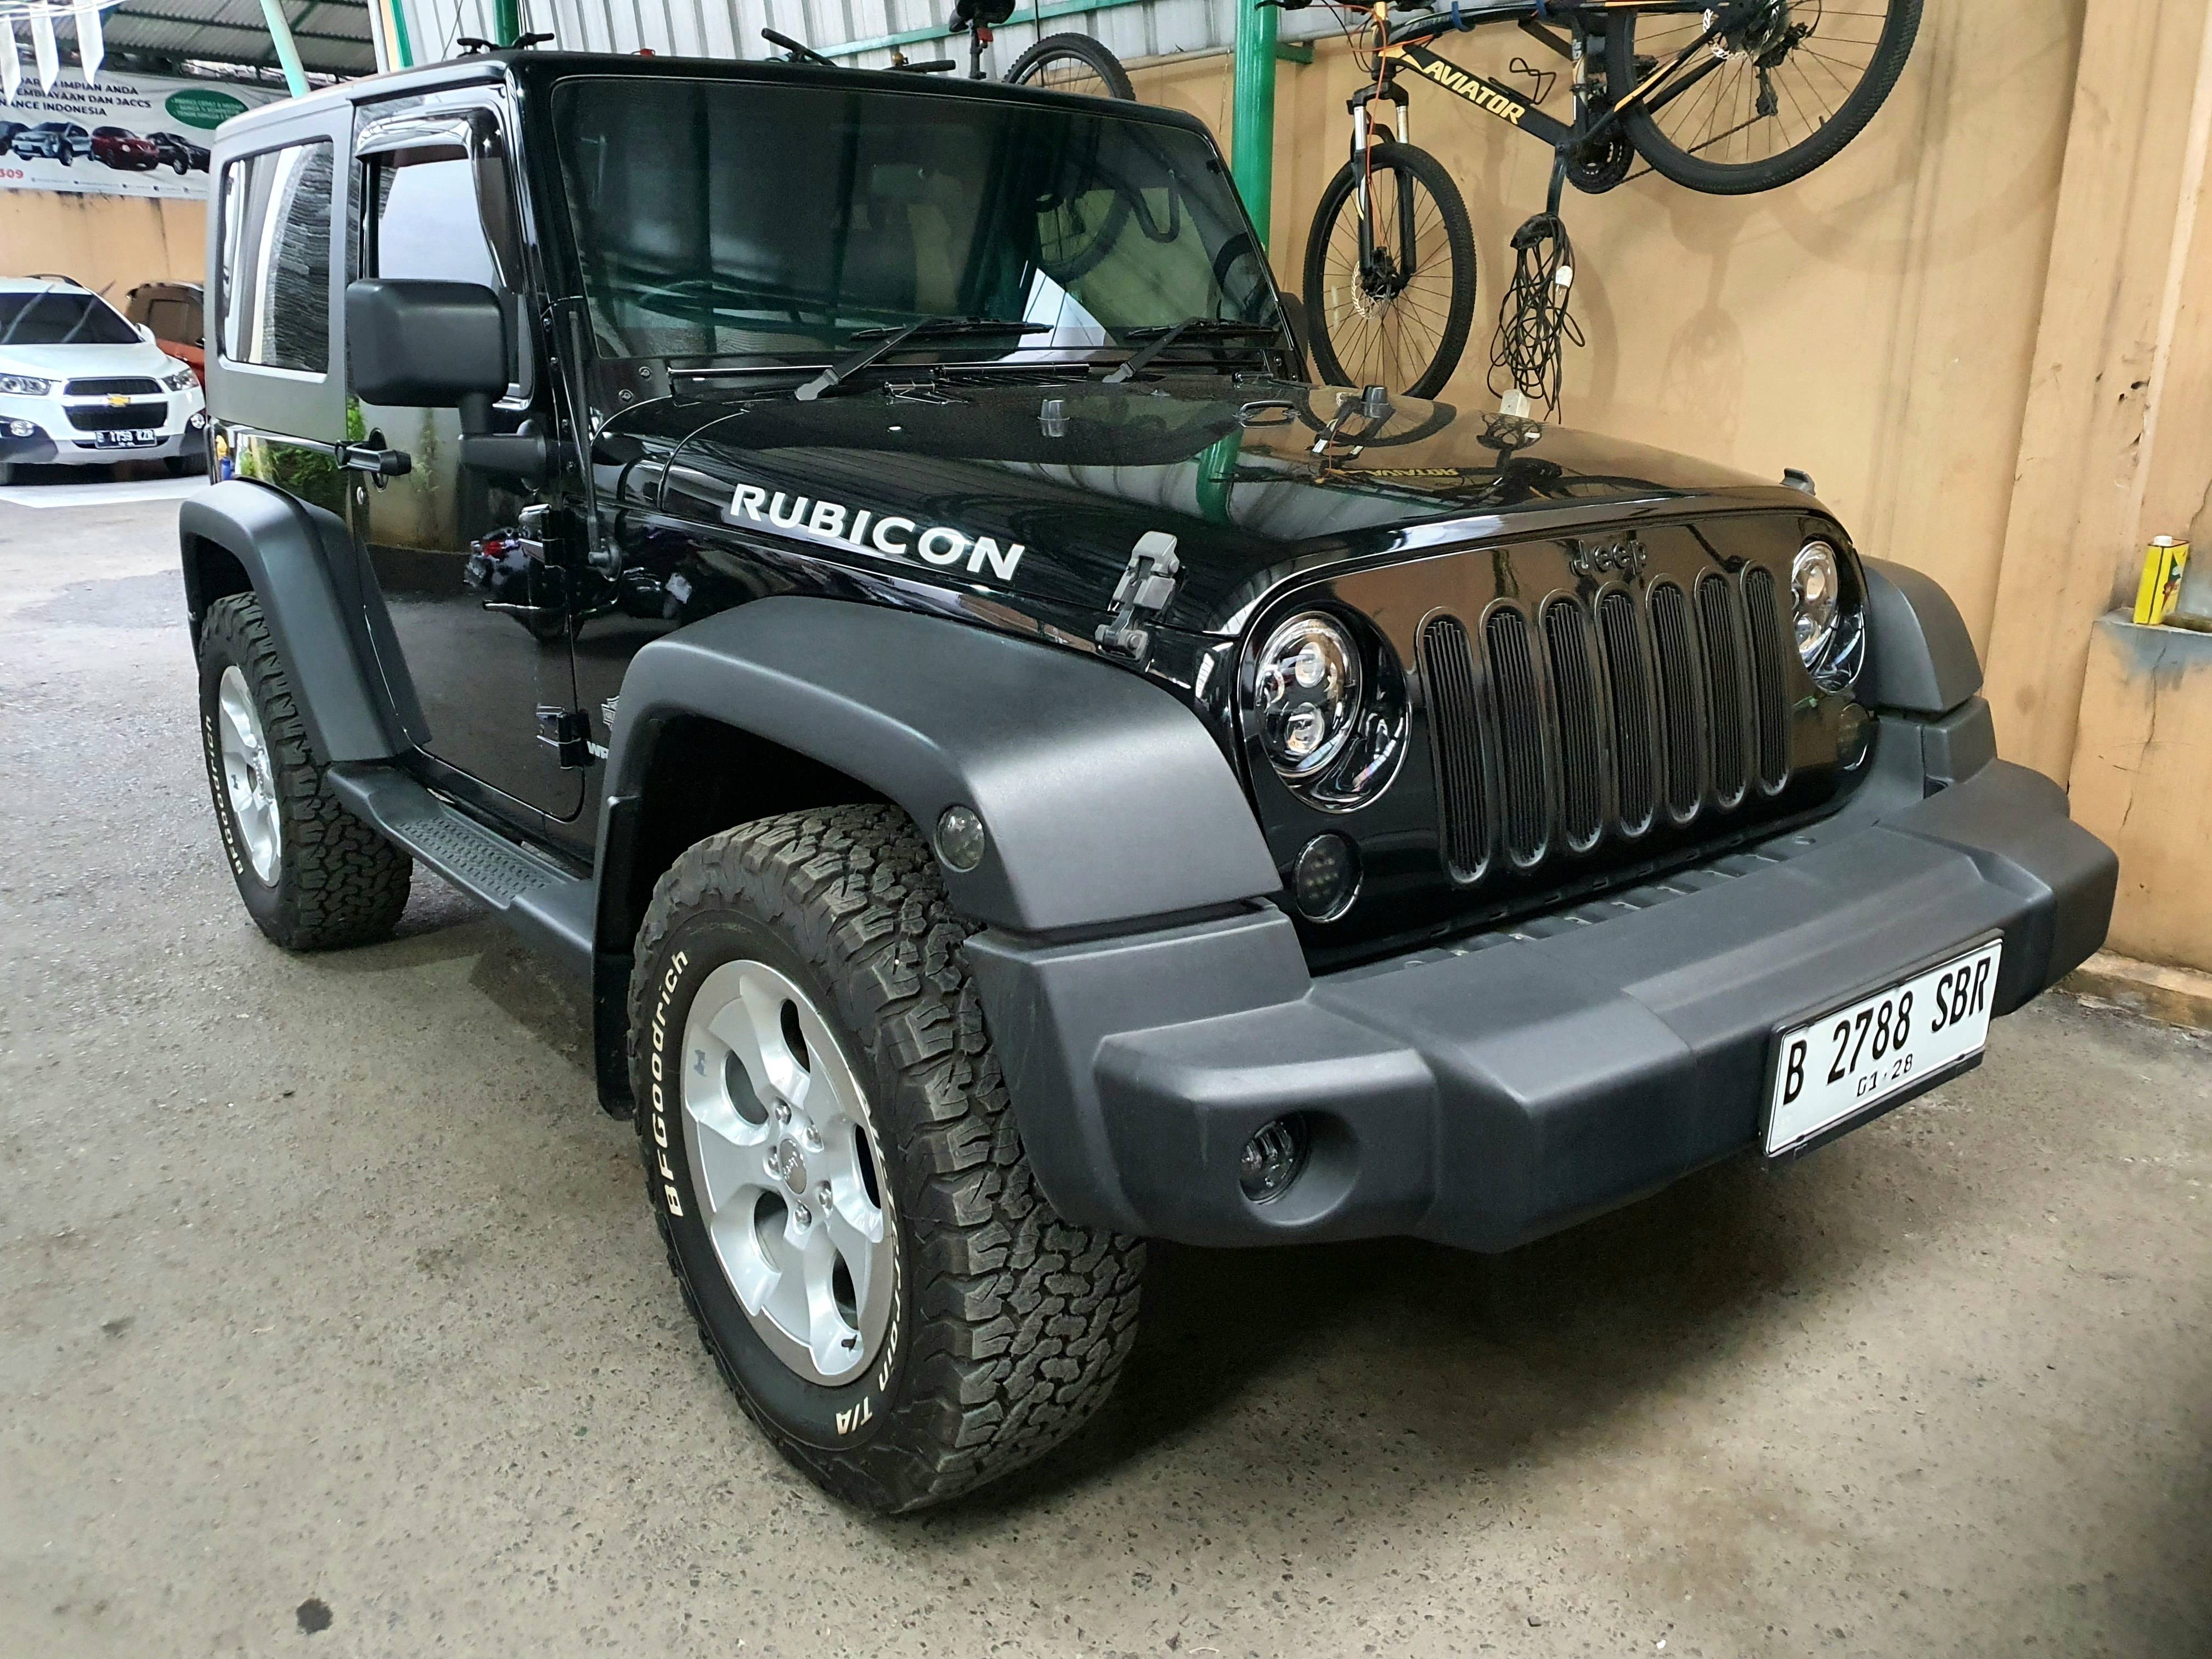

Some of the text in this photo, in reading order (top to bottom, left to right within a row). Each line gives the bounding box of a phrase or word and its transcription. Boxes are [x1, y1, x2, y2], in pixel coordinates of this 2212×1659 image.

[17, 87, 85, 102] EMBIAYAAN
[88, 94, 114, 104] DAN
[116, 97, 152, 109] JACCS
[43, 102, 108, 116] INDONESIA
[60, 80, 102, 92] IMPIAN
[105, 84, 139, 95] ANDA
[1425, 60, 1525, 125] AVIATOR
[730, 483, 1025, 581] RUBICON
[1569, 539, 1646, 576] Jeep
[206, 715, 244, 875] BFGoodrich
[1783, 956, 1991, 1106] B 2788 SBR
[652, 950, 689, 1217] BFGoodrich
[836, 1396, 873, 1436] T/A
